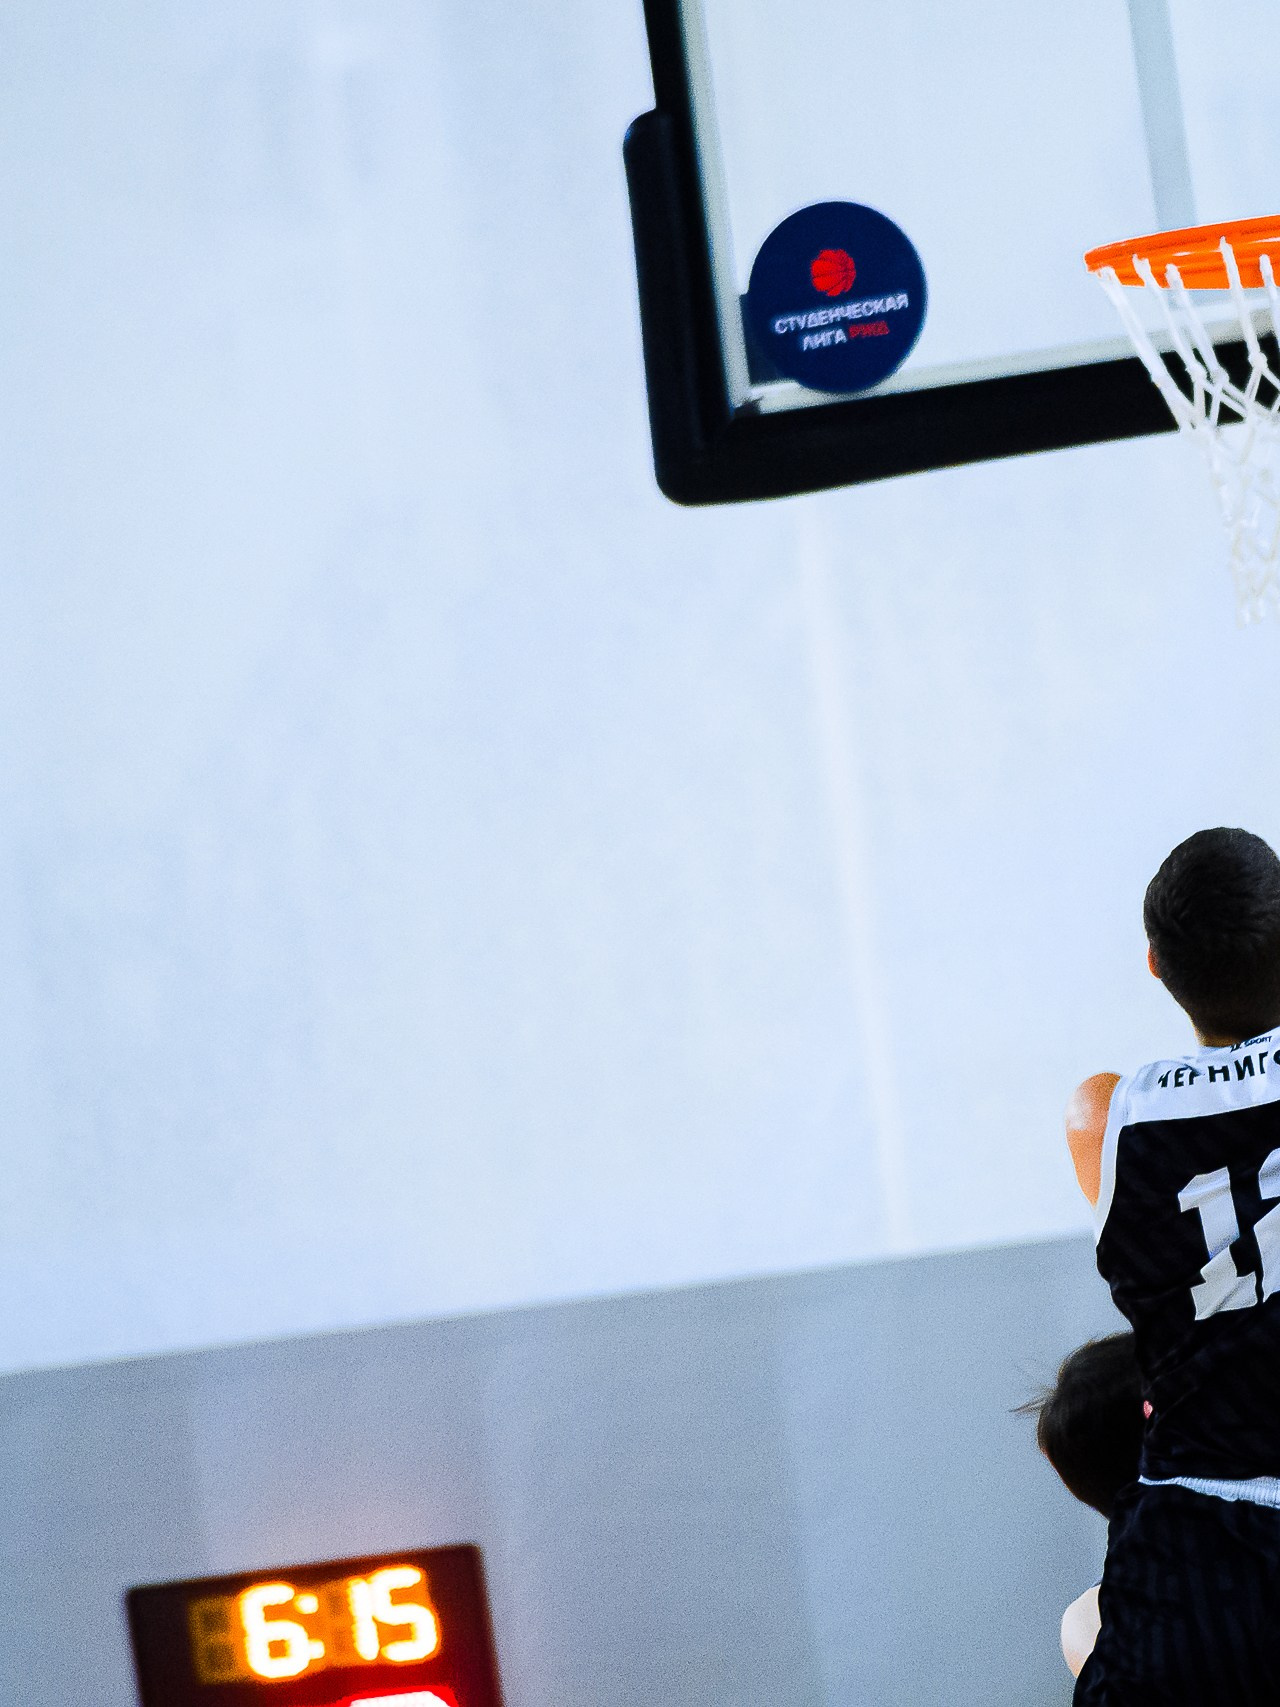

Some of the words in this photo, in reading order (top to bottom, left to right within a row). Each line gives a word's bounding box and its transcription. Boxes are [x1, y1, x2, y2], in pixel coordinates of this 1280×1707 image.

[774, 293, 909, 335] СТУДЕНЧЕСКАЯ
[803, 328, 848, 351] ЛИГА
[238, 1563, 440, 1679] 6:15
